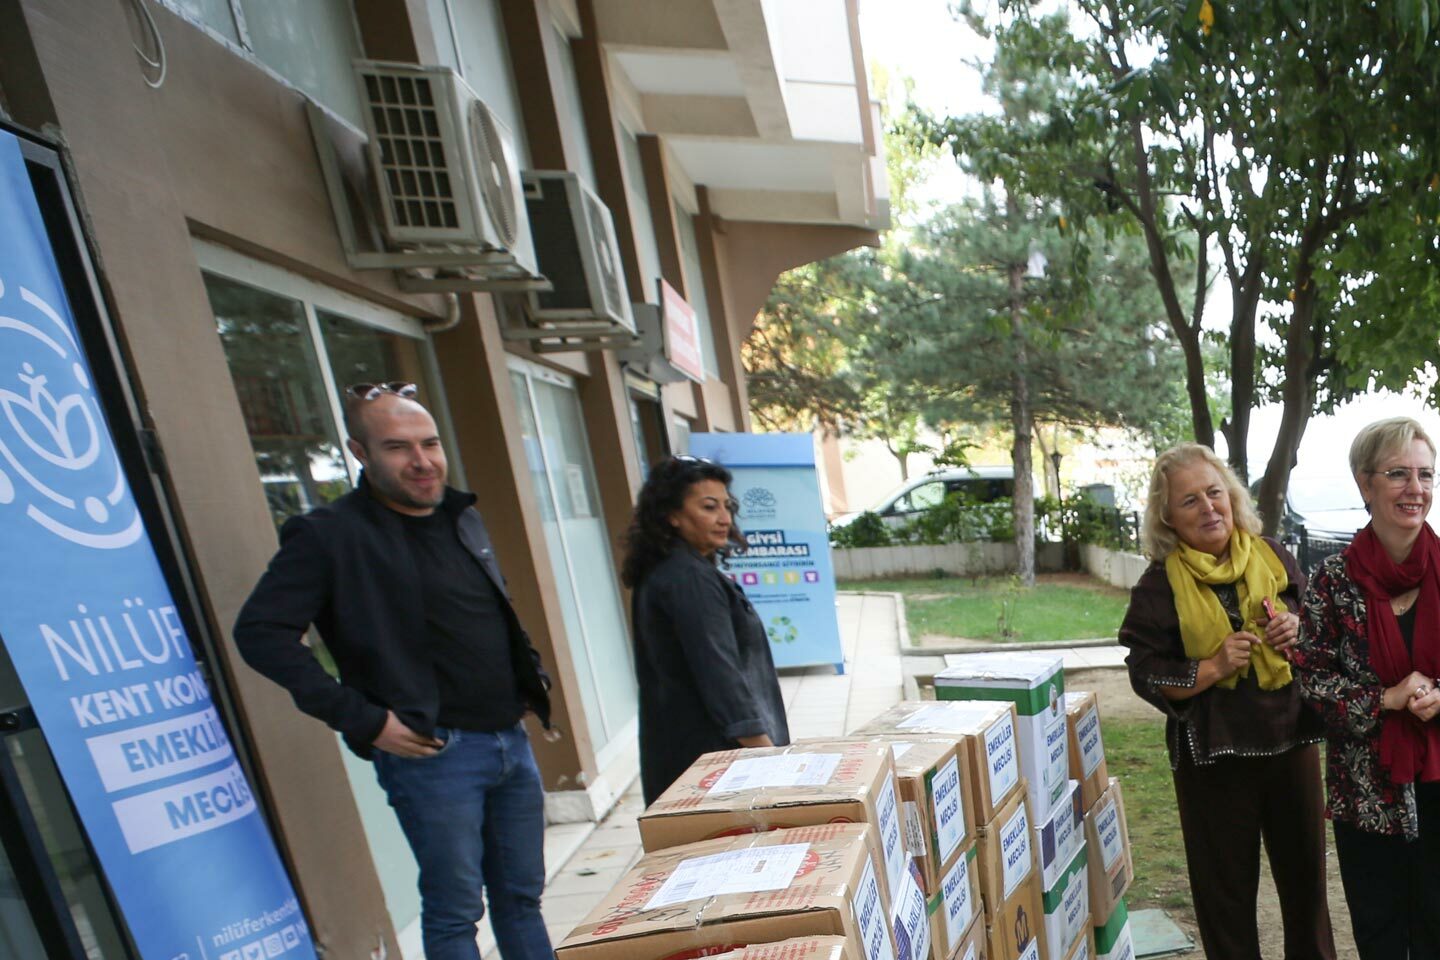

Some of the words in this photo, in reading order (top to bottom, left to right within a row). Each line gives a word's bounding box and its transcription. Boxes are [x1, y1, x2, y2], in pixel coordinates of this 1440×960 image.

[39, 597, 184, 681] NİLÜF
[70, 683, 154, 728] KENT
[154, 670, 210, 710] KON
[987, 724, 1012, 757] EMEKLİLER
[993, 746, 1012, 775] MECLİSİ
[935, 770, 958, 807] EMEKLİLER
[940, 792, 958, 829] MECLİSİ
[1003, 815, 1026, 852] EMEKLİLER
[1007, 837, 1027, 870] MECLİSİ
[944, 861, 966, 900] EMEKLİLER
[859, 878, 878, 940] EMEKLİLER
